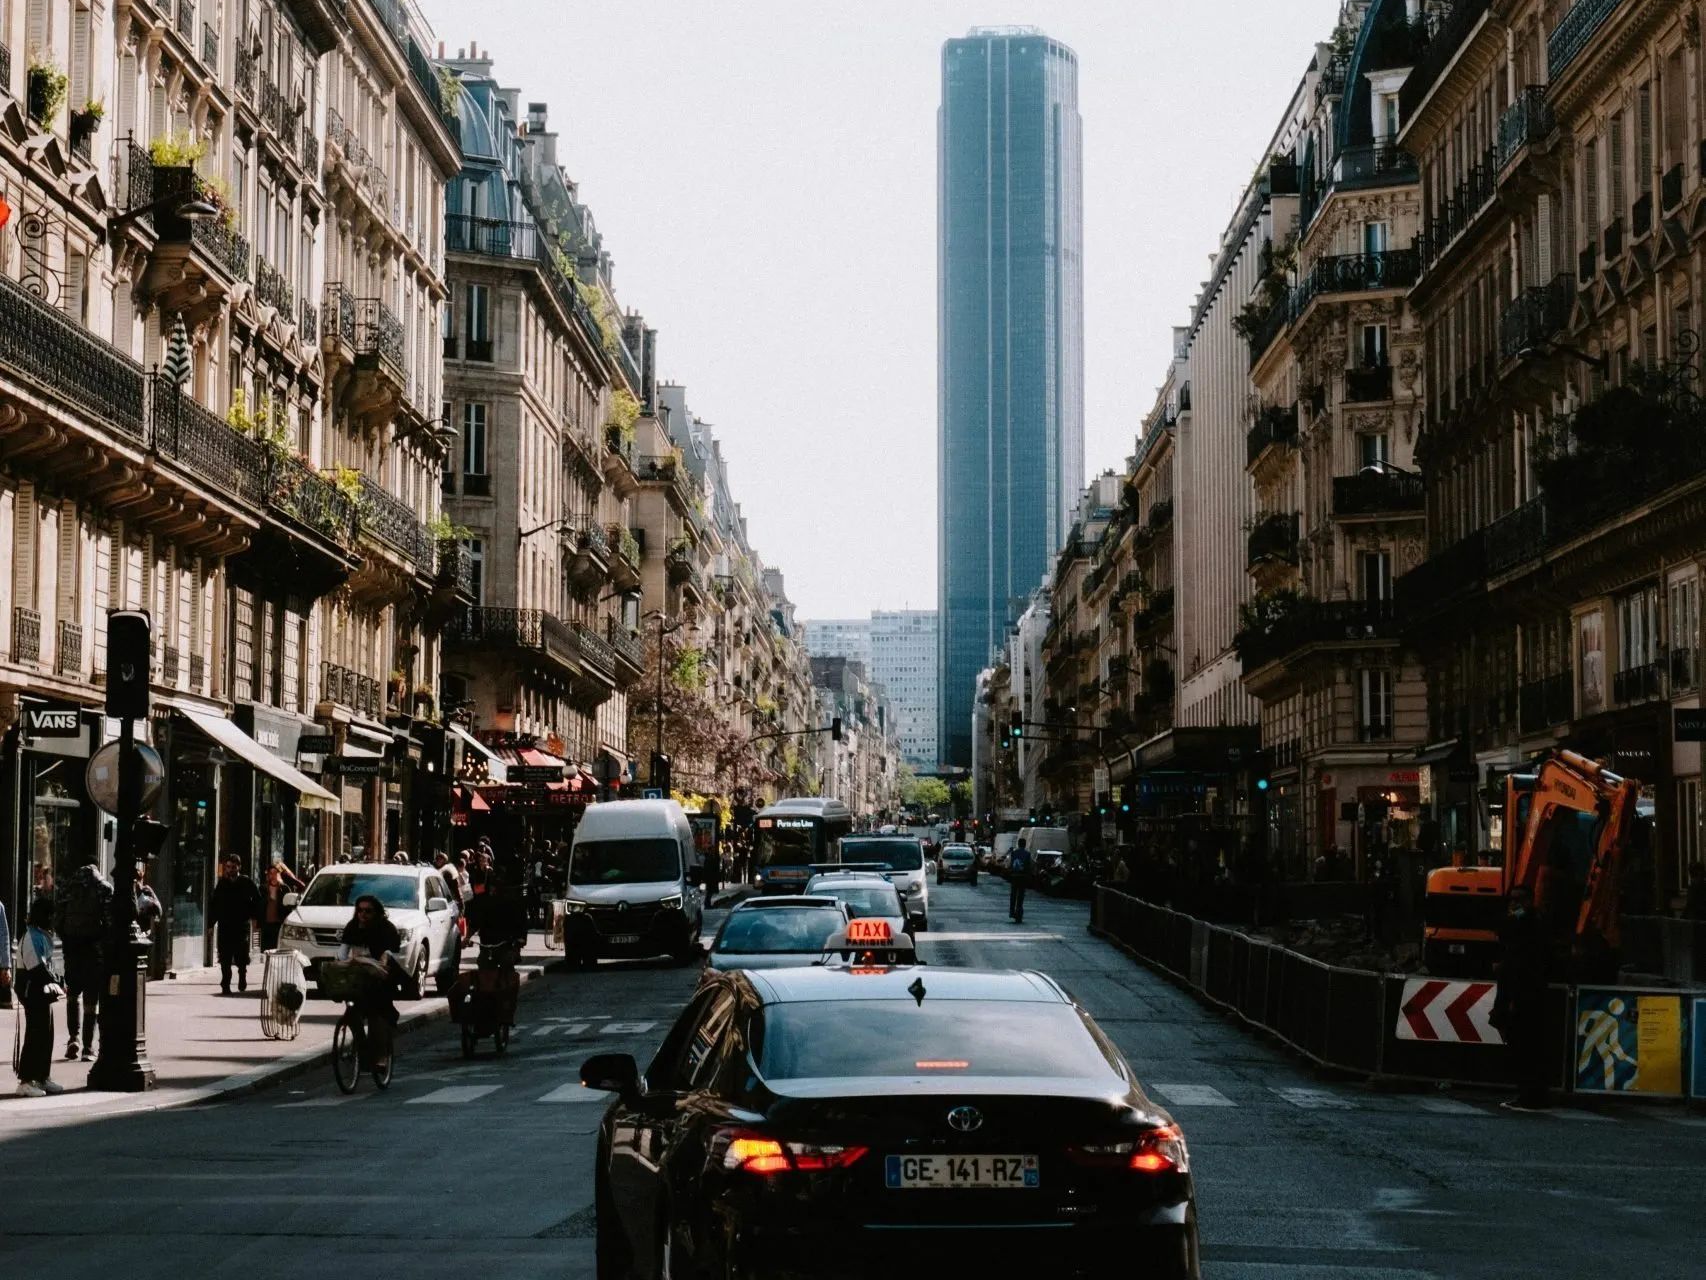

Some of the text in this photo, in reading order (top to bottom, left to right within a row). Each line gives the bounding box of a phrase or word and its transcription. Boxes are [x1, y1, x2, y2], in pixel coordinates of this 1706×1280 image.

[30, 710, 78, 729] VANS
[853, 922, 890, 937] TAXI
[845, 938, 894, 947] PARISIEN
